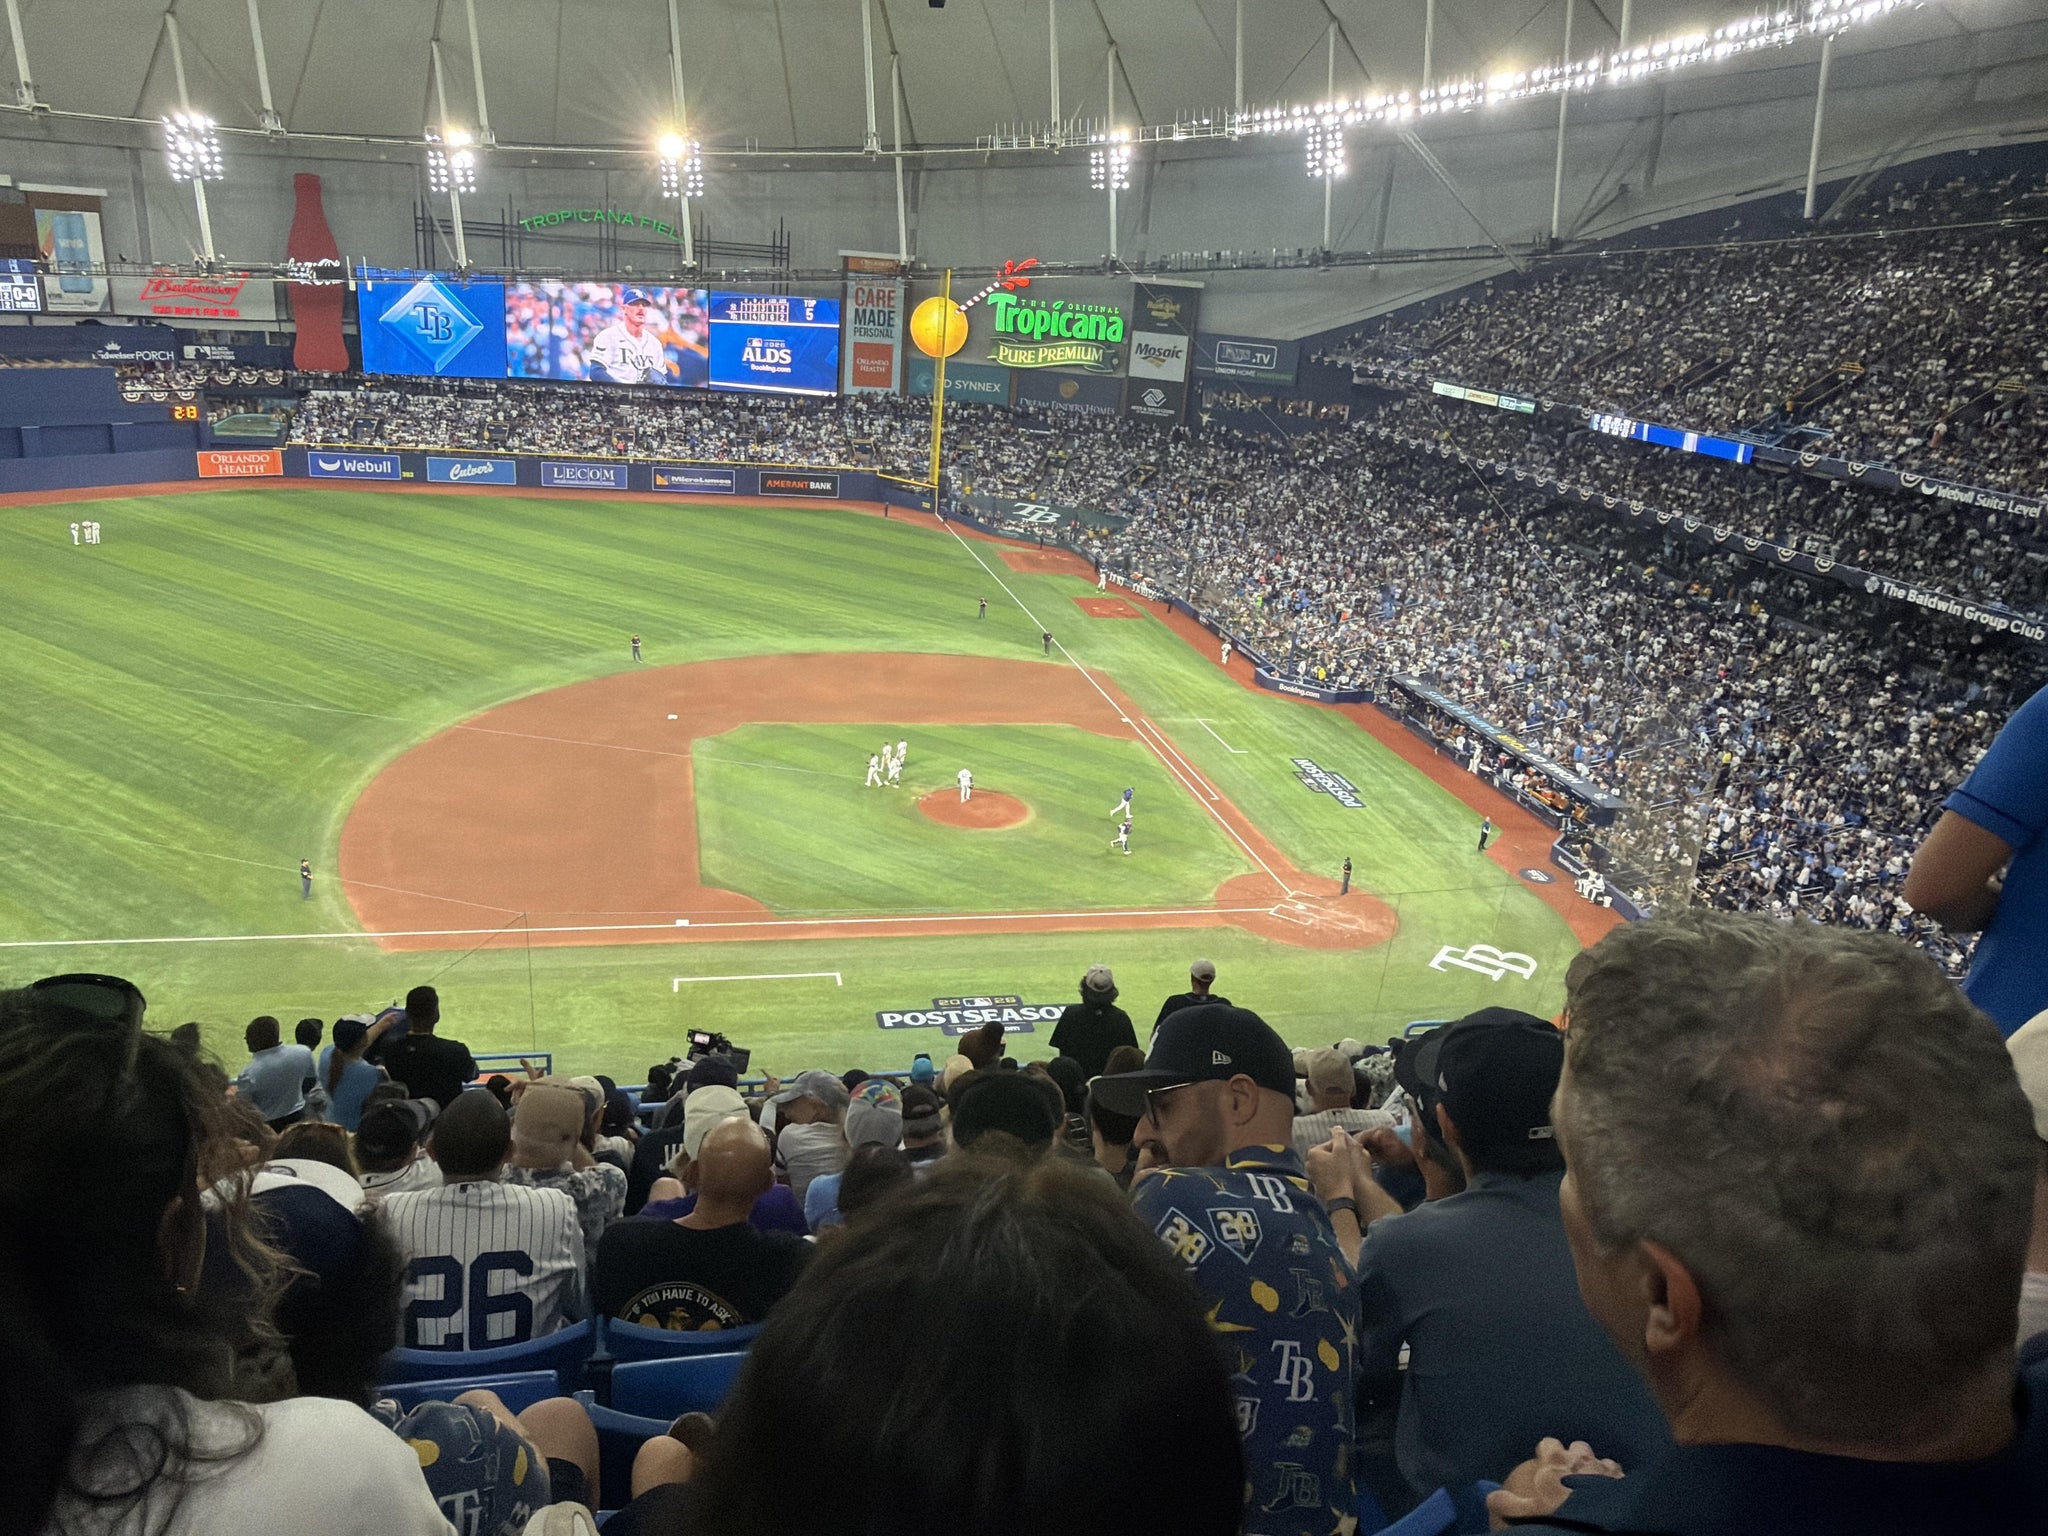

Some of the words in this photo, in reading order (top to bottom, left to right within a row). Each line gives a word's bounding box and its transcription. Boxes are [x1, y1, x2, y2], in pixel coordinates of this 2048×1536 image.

[520, 209, 635, 232] TROPICANA
[639, 216, 686, 243] FIEL
[804, 300, 817, 308] TOP
[854, 286, 896, 309] CARE
[805, 309, 814, 321] 5
[1021, 299, 1046, 308] THE
[1068, 303, 1120, 314] ORIGINAL
[413, 304, 450, 341] TB
[854, 308, 896, 328] MADE
[987, 292, 1124, 343] Tropicana
[853, 326, 895, 339] PERSONAL
[136, 351, 175, 361] PORCH
[620, 347, 654, 368] RAYS
[742, 347, 792, 364] ALDS
[999, 344, 1036, 363] PURE
[1038, 345, 1104, 362] PREMIUM
[1135, 342, 1183, 359] Mosaic
[750, 364, 792, 373] Booking.com
[857, 357, 890, 367] ORLANDO
[860, 365, 886, 373] HEALTH
[954, 379, 1001, 393] SYNNEX
[210, 454, 270, 464] ORLANDO
[343, 459, 392, 473] Webull
[218, 464, 265, 474] HEALTH
[450, 462, 494, 481] Culver's
[553, 467, 615, 481] LECOM
[766, 479, 809, 490] AMERANT
[809, 482, 832, 491] BANK
[1936, 486, 1975, 504] Webull
[1976, 493, 2007, 511] Suite
[2007, 499, 2043, 518] Level
[1013, 502, 1061, 523] TB
[1882, 581, 1907, 599] The
[1906, 589, 1963, 617] Baldwin
[1963, 606, 2010, 631] Group
[2010, 619, 2046, 641] Club
[1279, 683, 1320, 699] Booking.com
[1294, 759, 1363, 807] POSTSEASON
[1428, 944, 1537, 981] TB
[938, 999, 960, 1007] 20
[995, 996, 1017, 1006] 26
[404, 1251, 534, 1352] 26
[641, 1292, 660, 1307] YOU
[662, 1288, 694, 1301] HAVE
[696, 1292, 709, 1307] TO
[1271, 1340, 1319, 1402] TB
